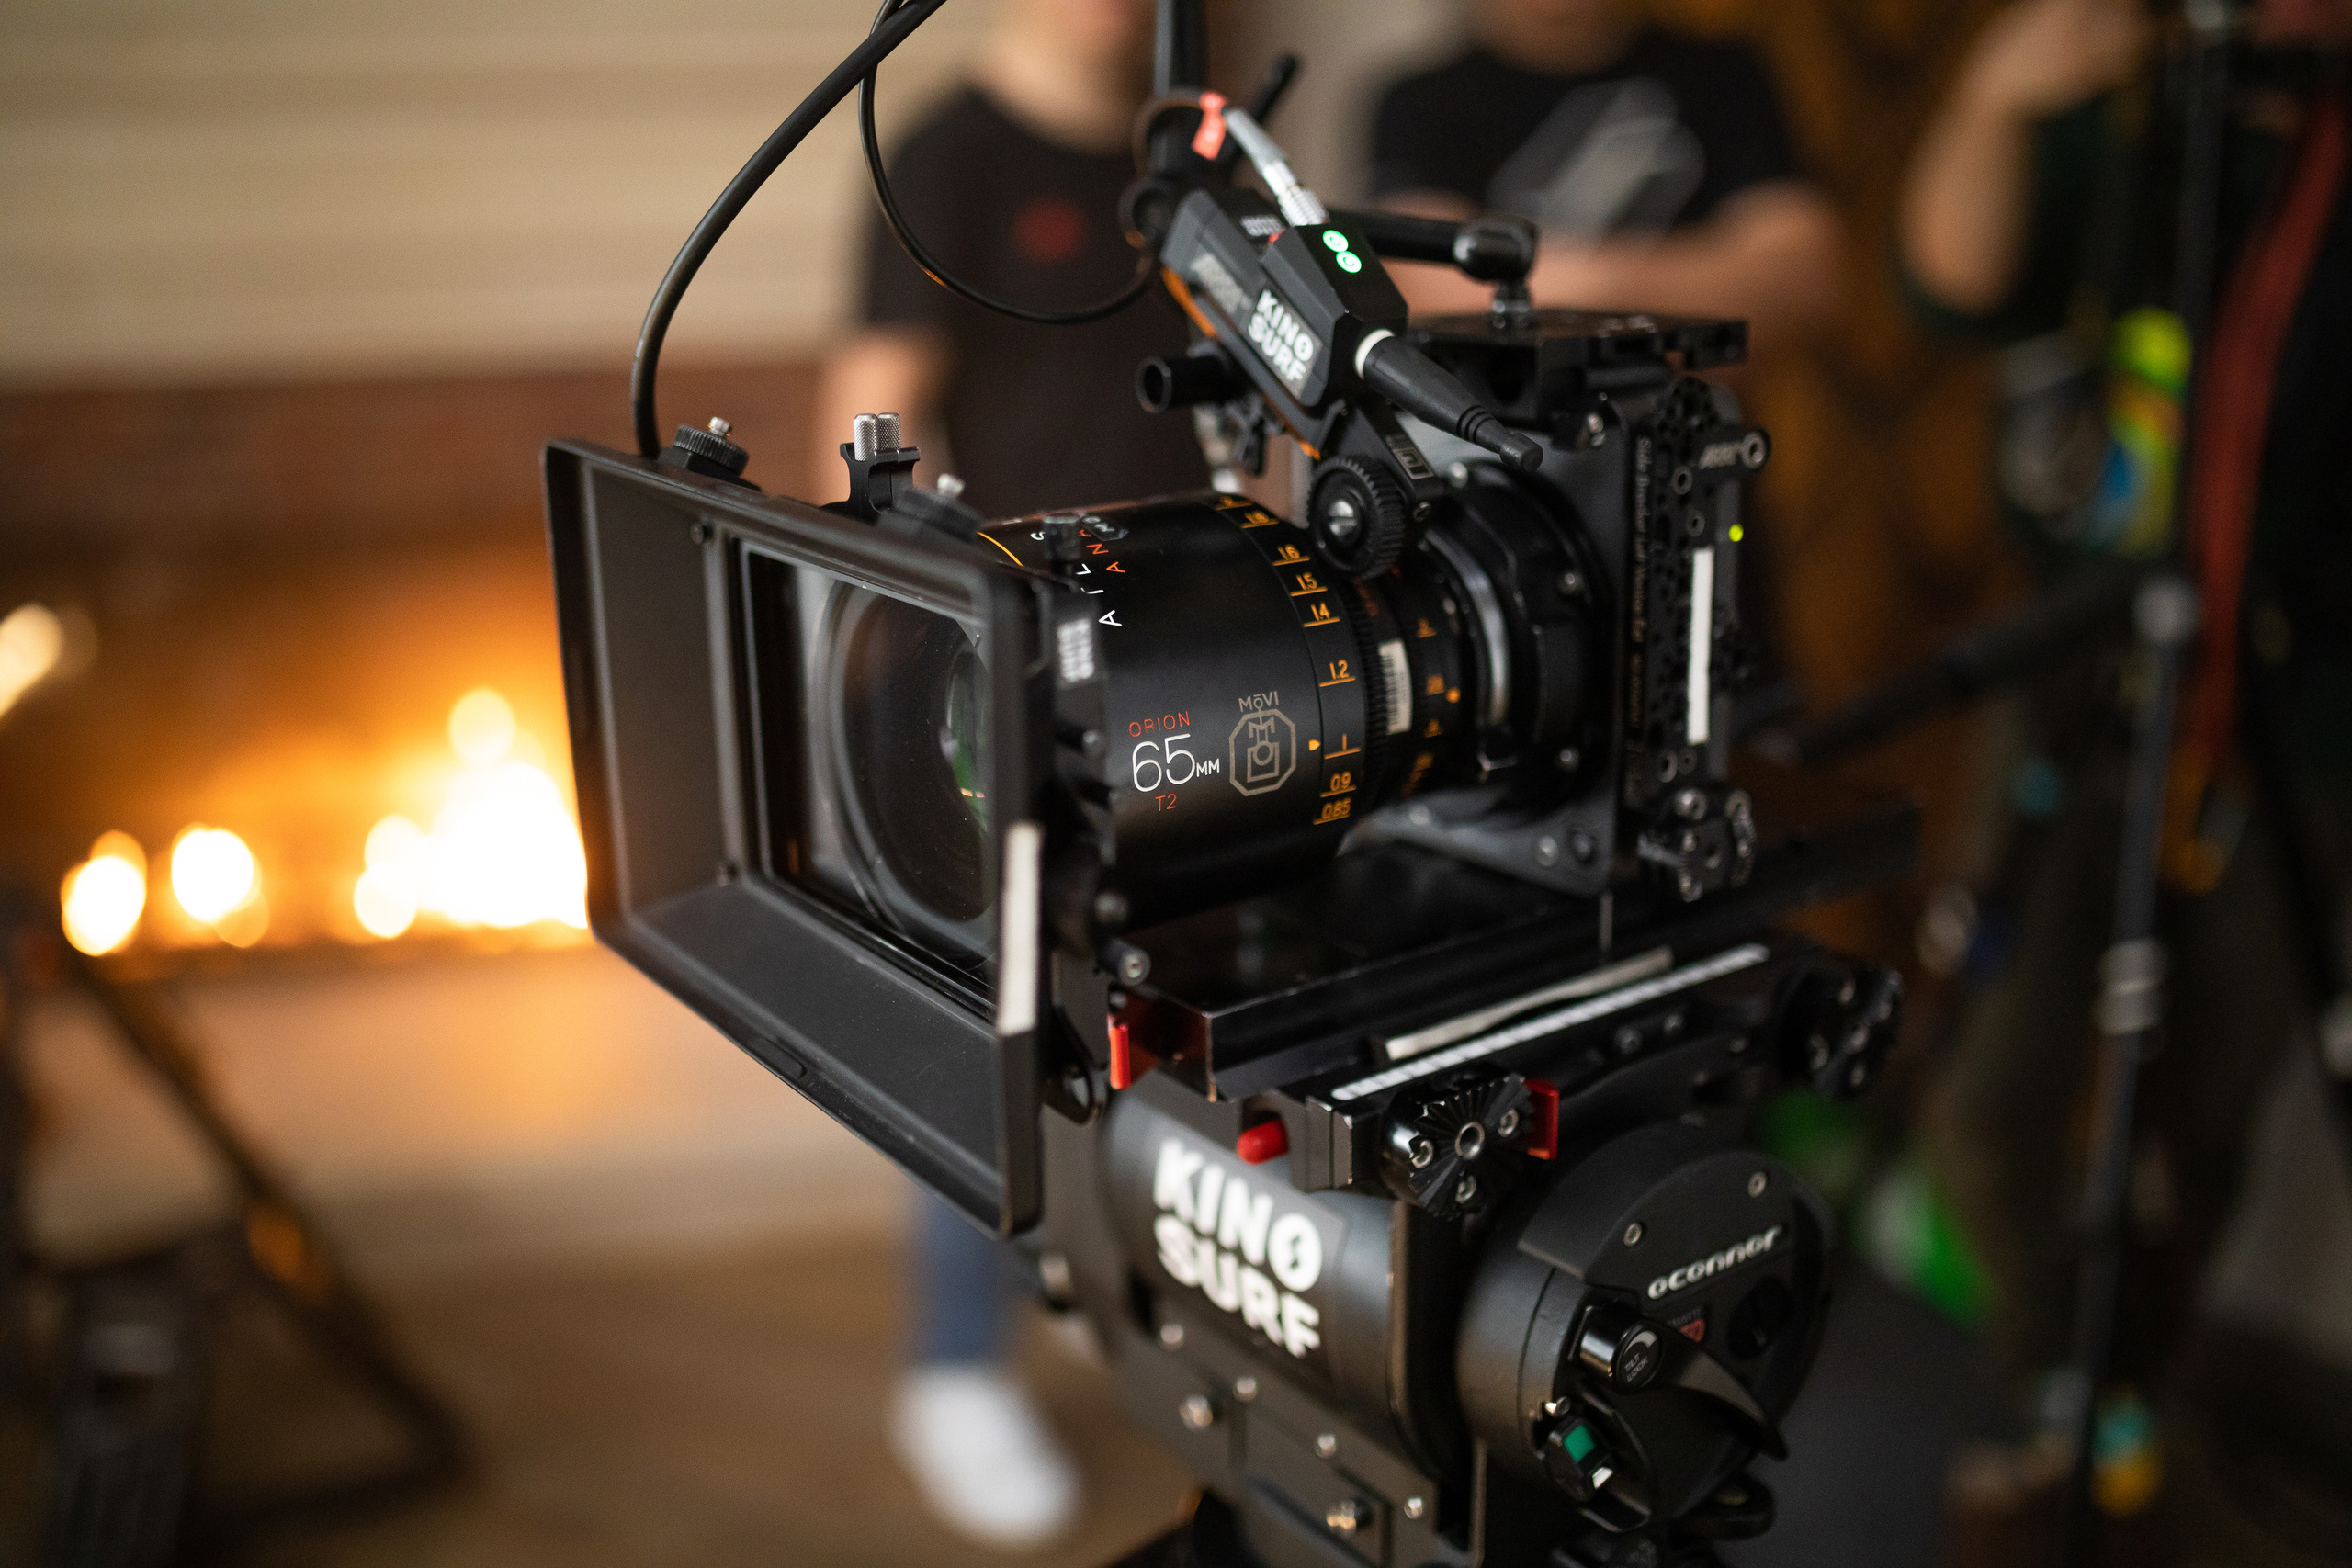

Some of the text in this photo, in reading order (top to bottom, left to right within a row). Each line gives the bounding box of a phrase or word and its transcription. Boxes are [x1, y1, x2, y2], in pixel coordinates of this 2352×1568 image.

[1248, 313, 1306, 380] SURF
[1256, 288, 1314, 362] KINO
[1329, 659, 1350, 680] 1.2
[1128, 710, 1192, 738] ORION
[1155, 793, 1178, 812] T2
[1153, 1138, 1323, 1292] KINO
[1153, 1213, 1321, 1359] SURF
[1647, 1225, 1781, 1300] oconnor
